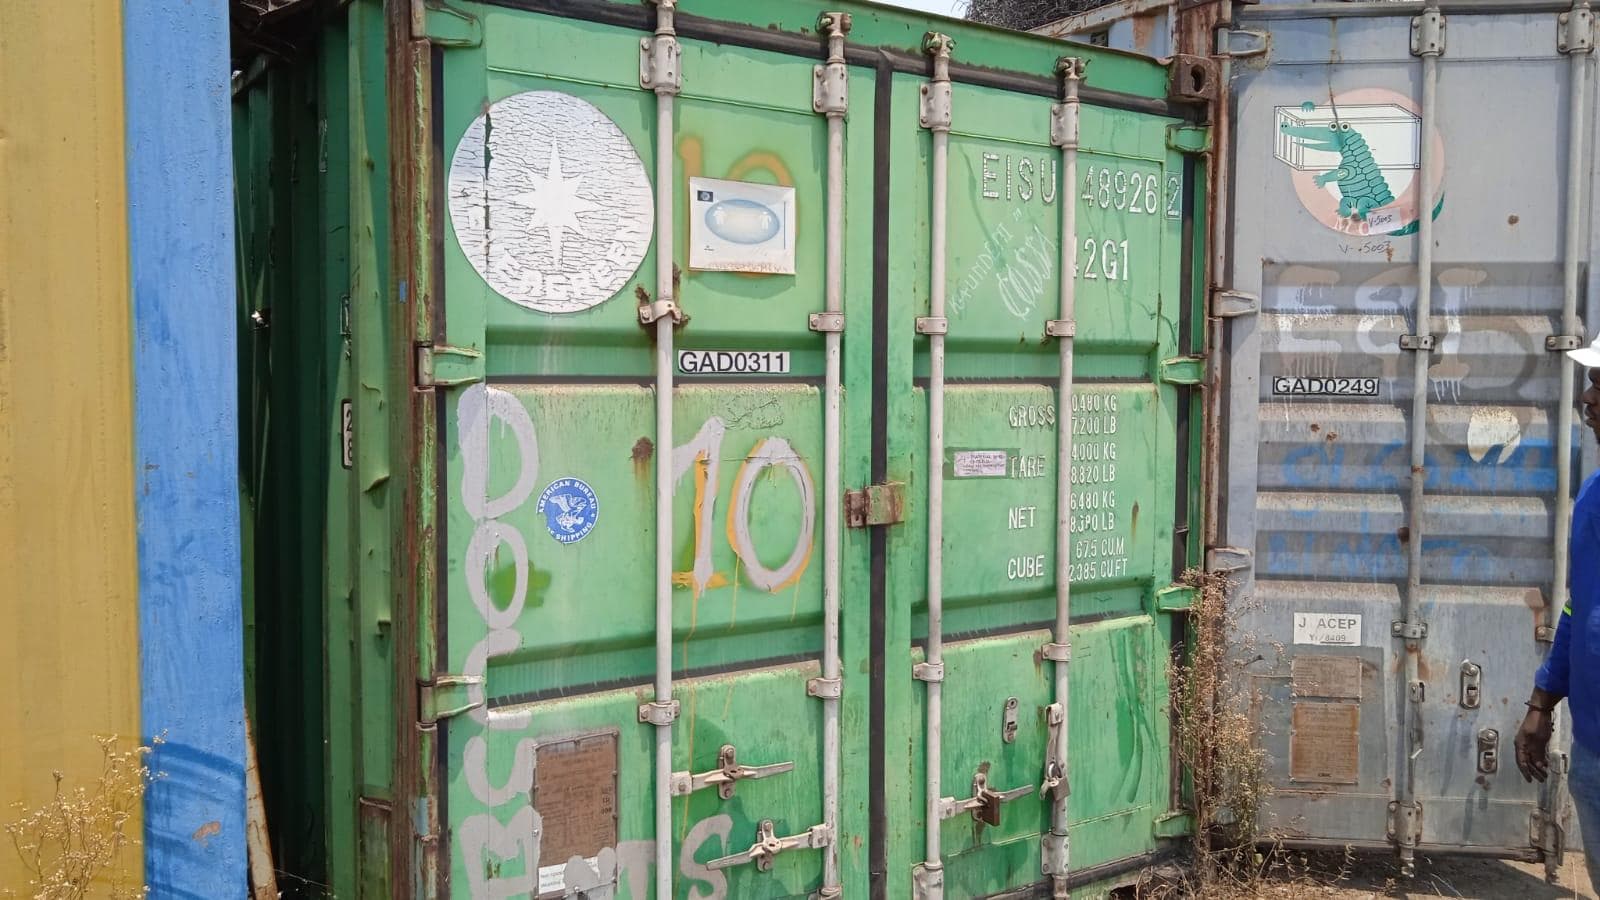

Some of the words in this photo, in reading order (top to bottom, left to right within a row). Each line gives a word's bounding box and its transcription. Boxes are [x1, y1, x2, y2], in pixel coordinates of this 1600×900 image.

[982, 152, 1057, 203] EISU
[1081, 166, 1158, 214] 48926
[1166, 177, 1181, 216] 2
[680, 351, 785, 373] GAD0311
[1275, 377, 1377, 395] GAD0249
[1103, 395, 1118, 412] KG
[1009, 405, 1056, 428] GROSS
[1103, 416, 1117, 434] LB
[1103, 442, 1117, 460] KG
[1009, 455, 1046, 478] TARE
[1071, 465, 1099, 484] 8.820
[1102, 464, 1116, 482] LB
[538, 480, 570, 513] AMERICAN
[573, 481, 597, 509] BUREAU
[1102, 490, 1115, 508] KG
[1008, 507, 1036, 529] NET
[1102, 512, 1115, 530] LB
[1076, 540, 1097, 559] 67.5
[1007, 555, 1044, 579] CUBE
[1298, 618, 1306, 628] J
[1316, 618, 1357, 629] ACEP
